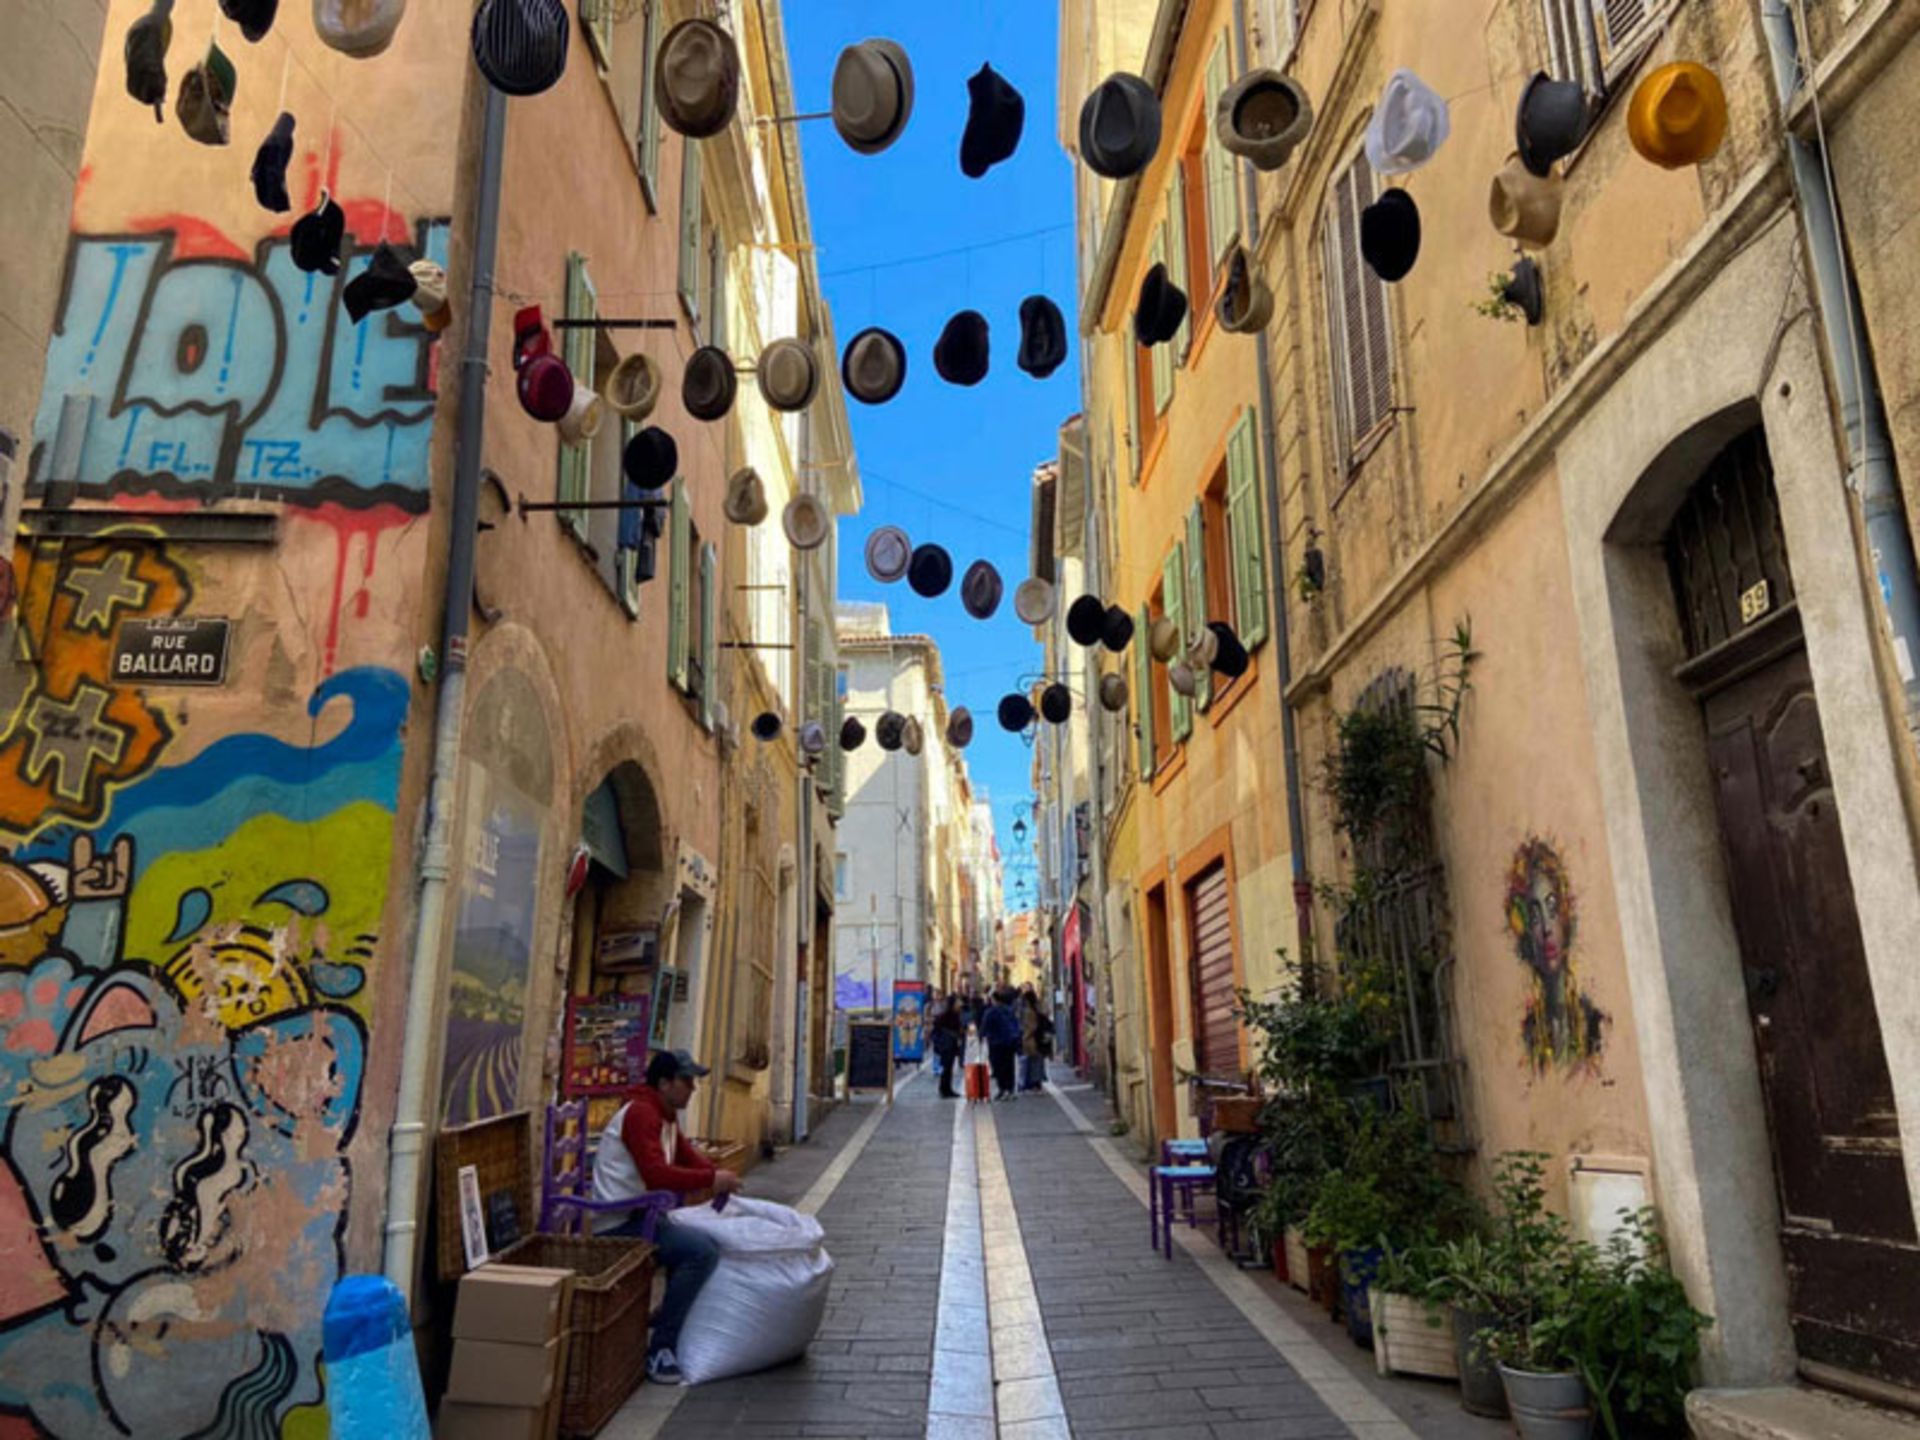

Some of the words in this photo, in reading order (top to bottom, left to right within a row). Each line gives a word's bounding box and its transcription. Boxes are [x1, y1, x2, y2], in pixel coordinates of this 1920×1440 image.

[1743, 584, 1765, 618] 39
[151, 634, 187, 650] RUE
[118, 653, 215, 674] BALLARD
